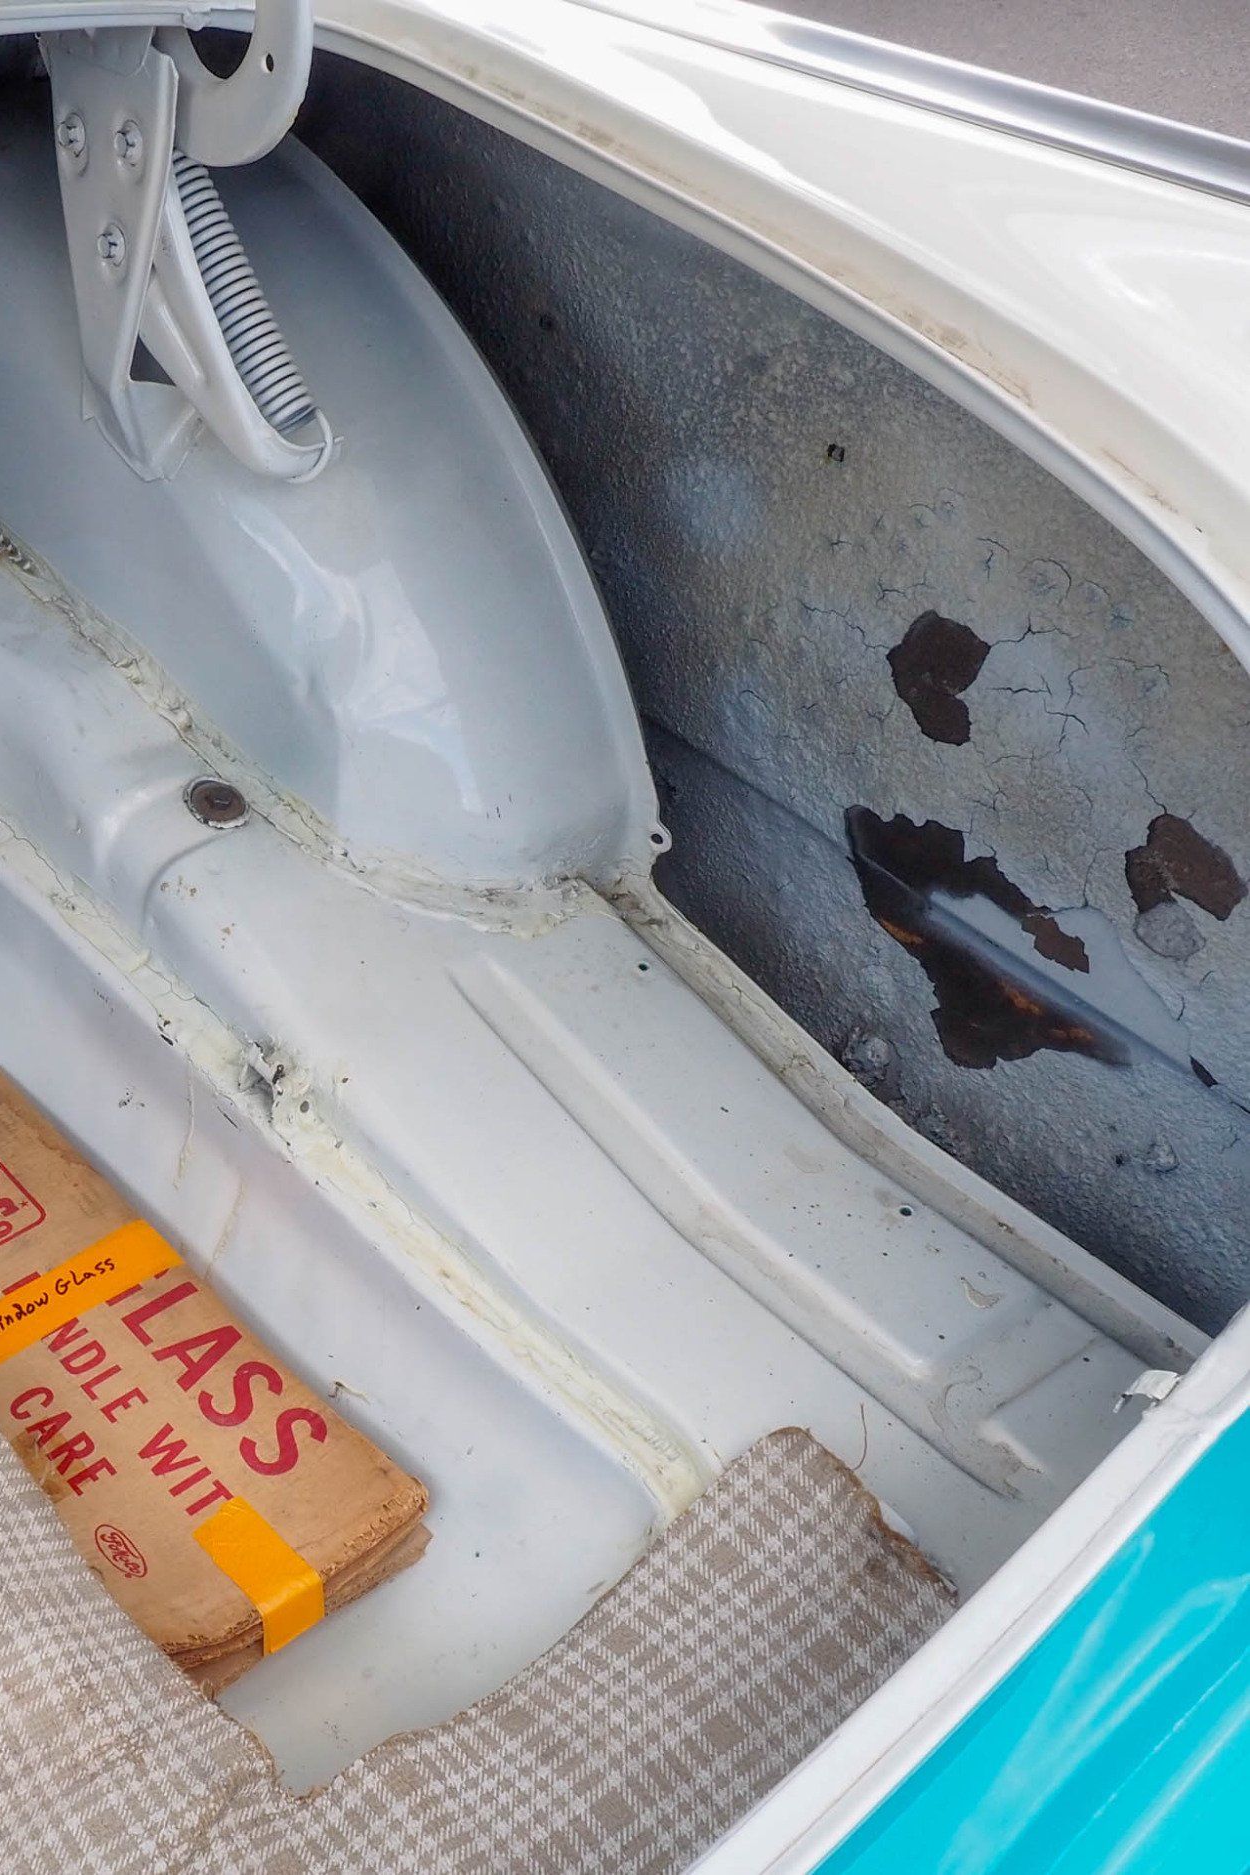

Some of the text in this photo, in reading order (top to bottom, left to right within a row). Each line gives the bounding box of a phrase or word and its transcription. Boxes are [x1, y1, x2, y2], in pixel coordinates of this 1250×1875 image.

[106, 1268, 327, 1477] LASS
[10, 1386, 118, 1496] CARE
[138, 1423, 234, 1517] WIT
